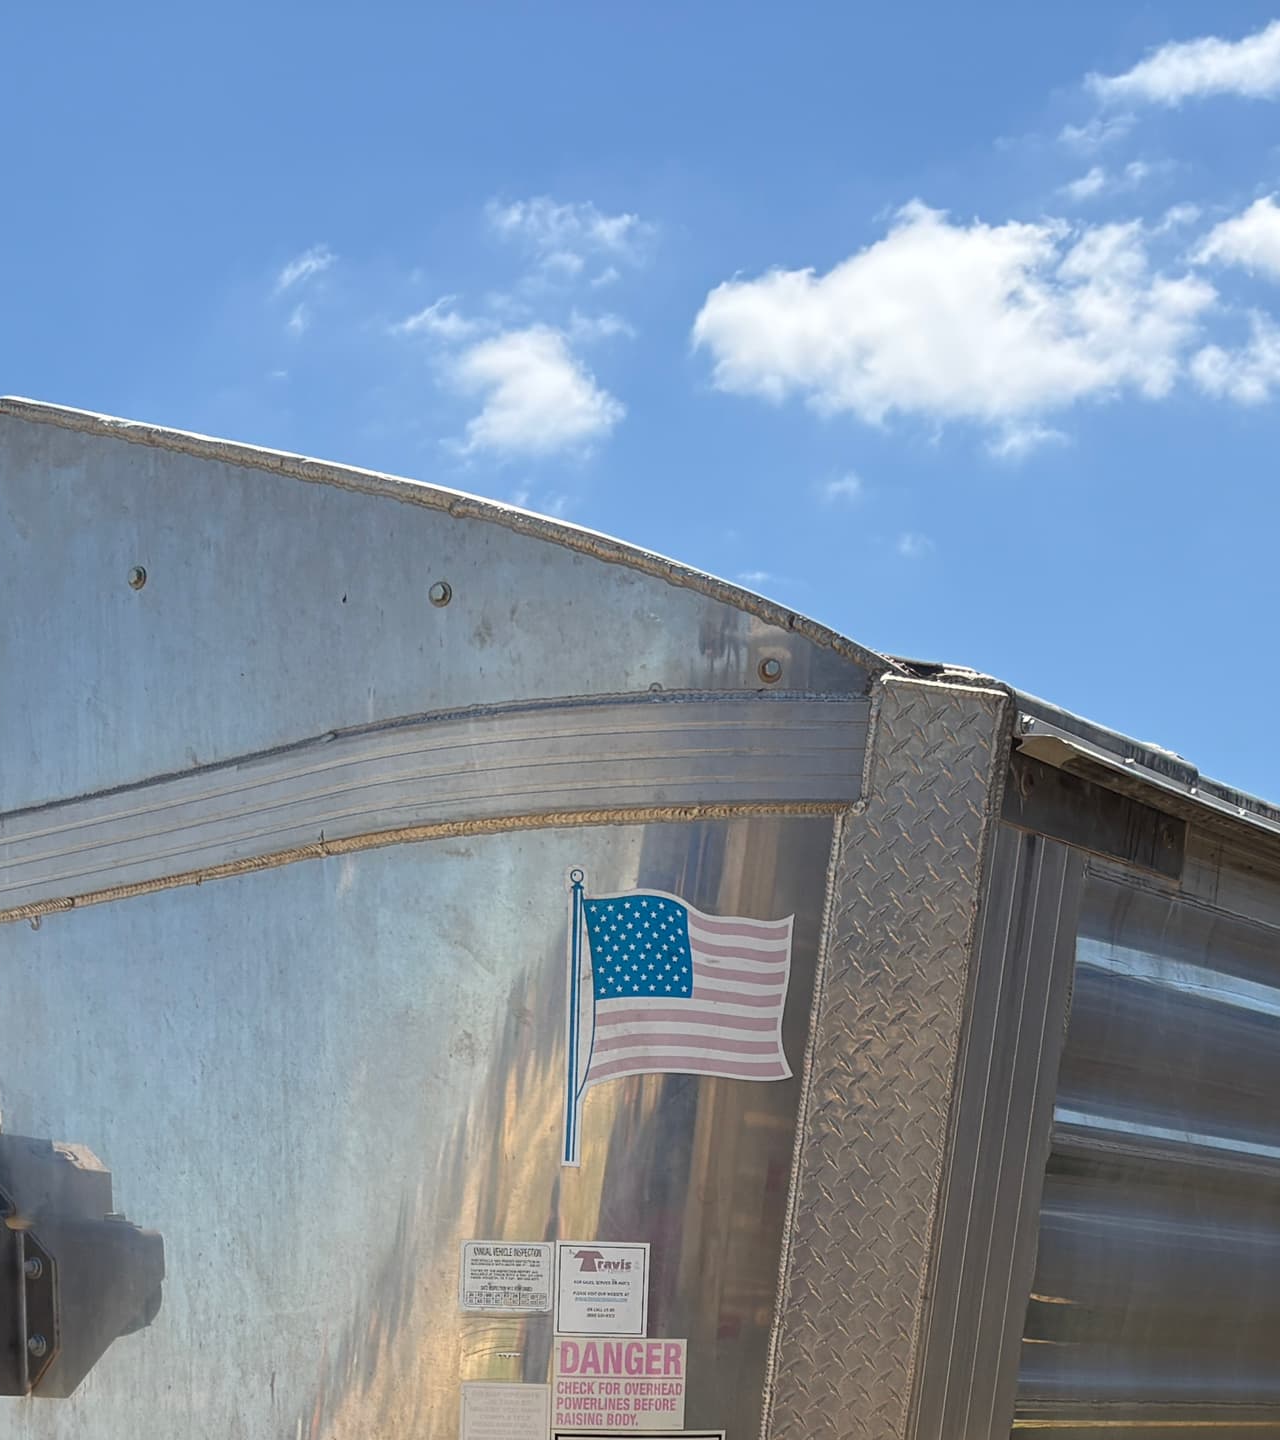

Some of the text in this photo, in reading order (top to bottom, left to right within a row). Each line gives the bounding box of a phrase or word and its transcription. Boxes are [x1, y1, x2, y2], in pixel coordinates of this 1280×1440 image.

[493, 1247, 512, 1257] VEHICLE
[513, 1247, 542, 1258] INSPECTION
[574, 1250, 632, 1272] Travis
[559, 1341, 682, 1376] DANGER
[557, 1381, 682, 1396] CHECK FOR OVERHEAD
[556, 1397, 676, 1411] POWERLINES BEFORE
[556, 1413, 638, 1426] RAISING BODY.
